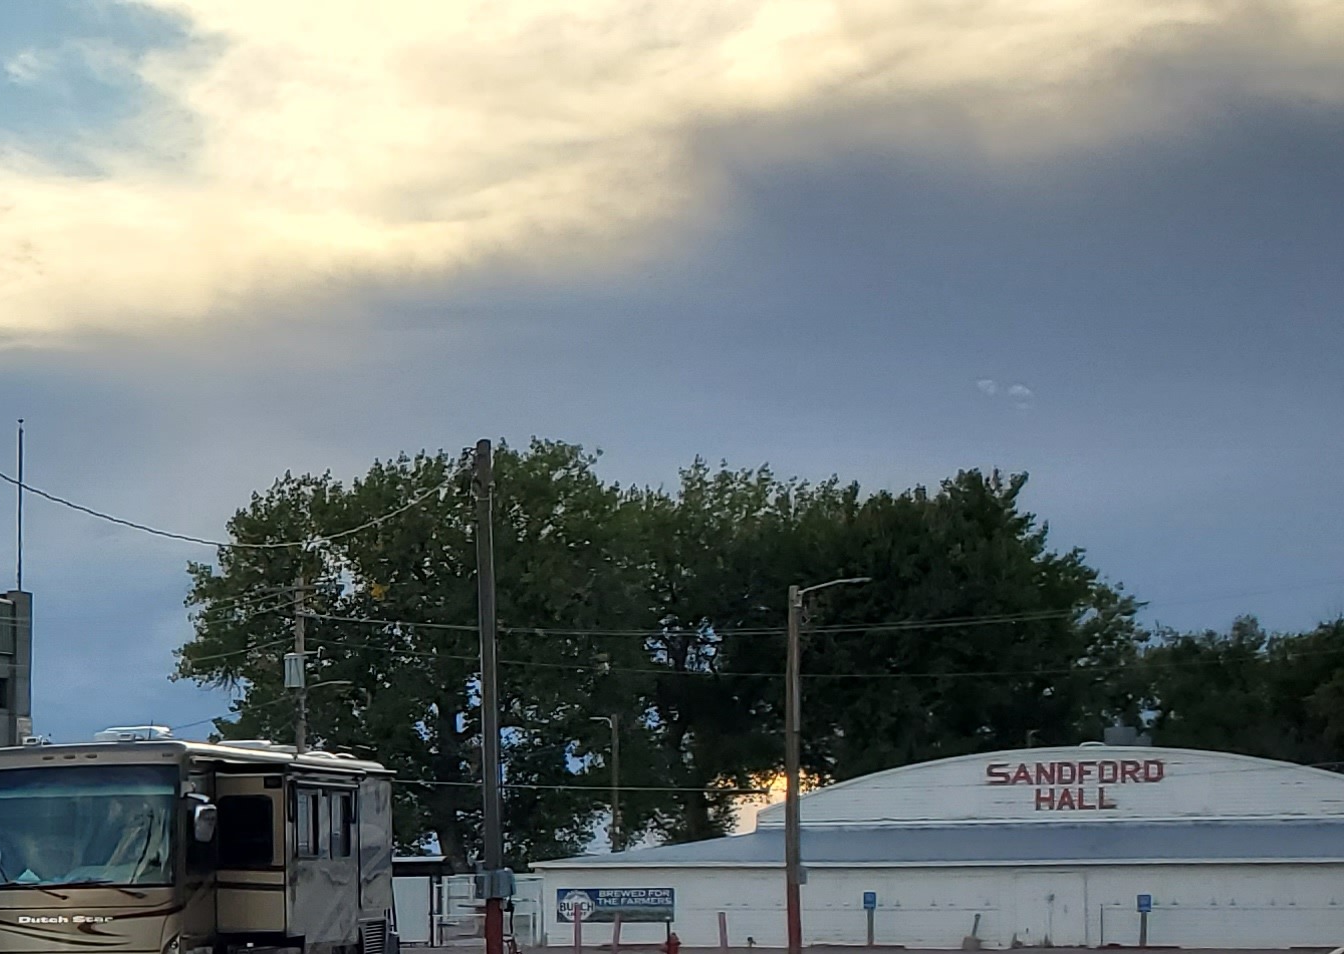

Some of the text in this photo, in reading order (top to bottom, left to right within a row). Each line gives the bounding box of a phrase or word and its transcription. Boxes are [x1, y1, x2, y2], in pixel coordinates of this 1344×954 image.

[986, 760, 1165, 785] SANDFORD
[1035, 787, 1118, 811] HALL
[560, 902, 594, 911] BUCH
[72, 915, 113, 923] Star
